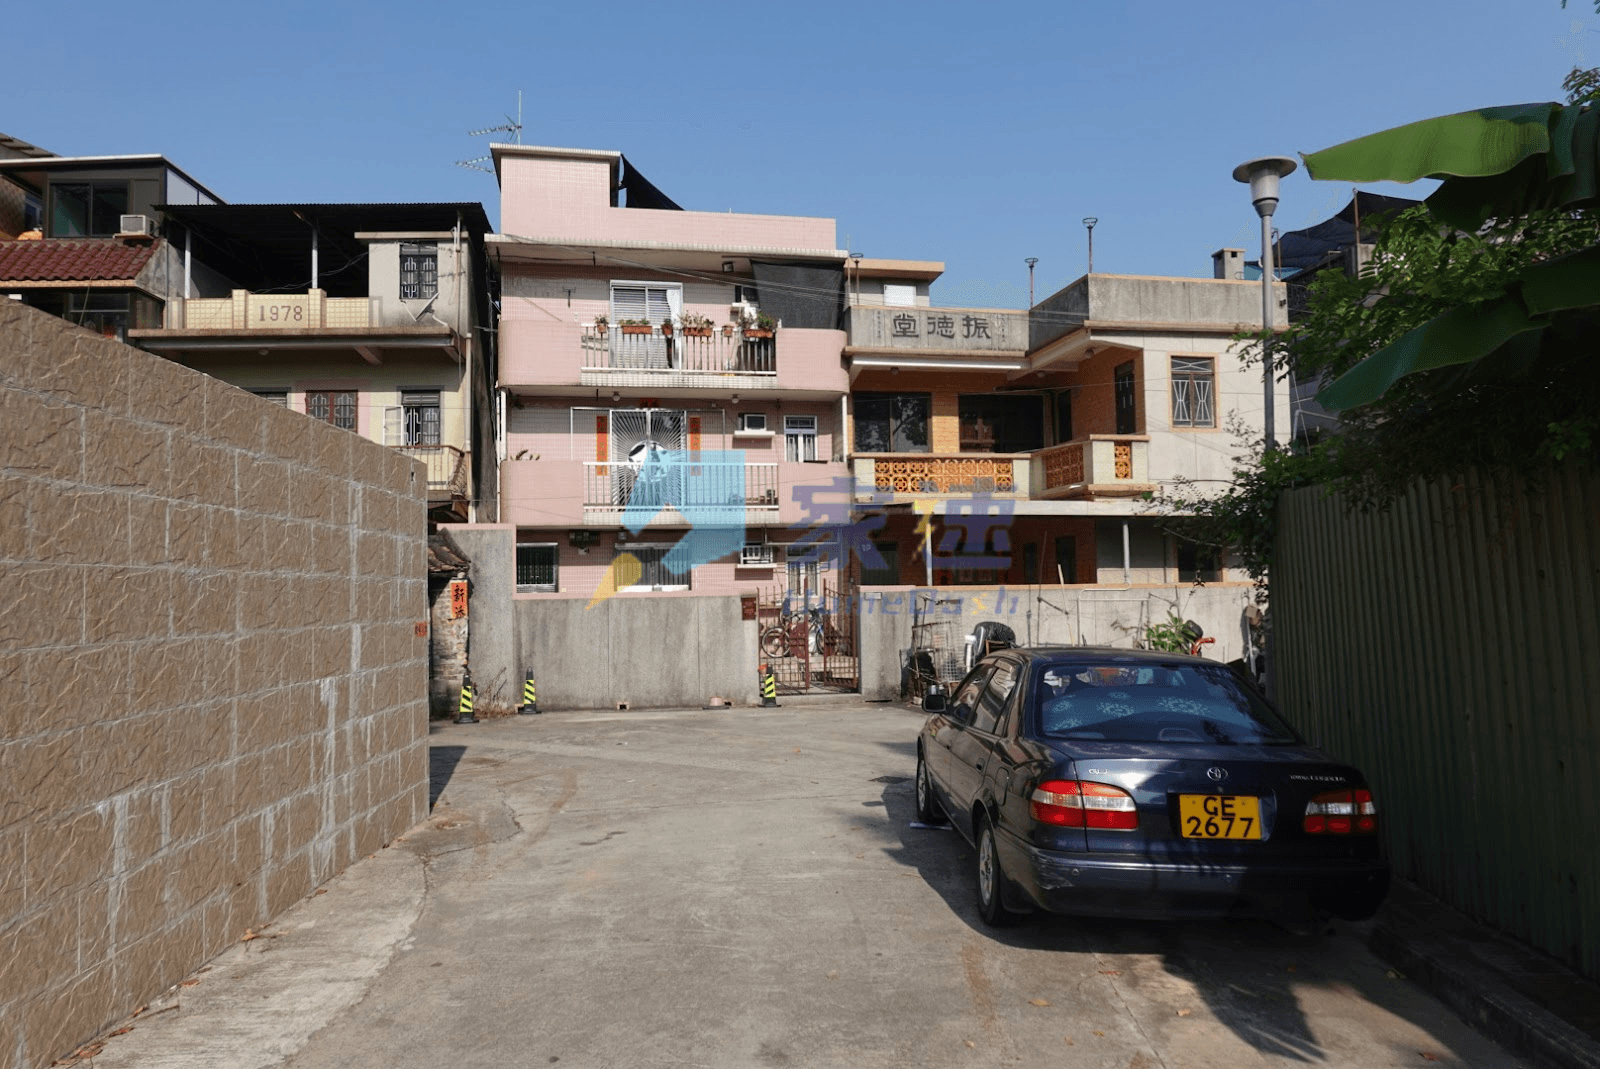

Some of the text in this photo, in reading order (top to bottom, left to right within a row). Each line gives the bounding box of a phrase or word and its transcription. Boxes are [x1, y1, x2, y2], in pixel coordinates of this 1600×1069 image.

[259, 304, 303, 321] 1978
[1203, 796, 1237, 817] GE
[1186, 816, 1254, 838] 2677
